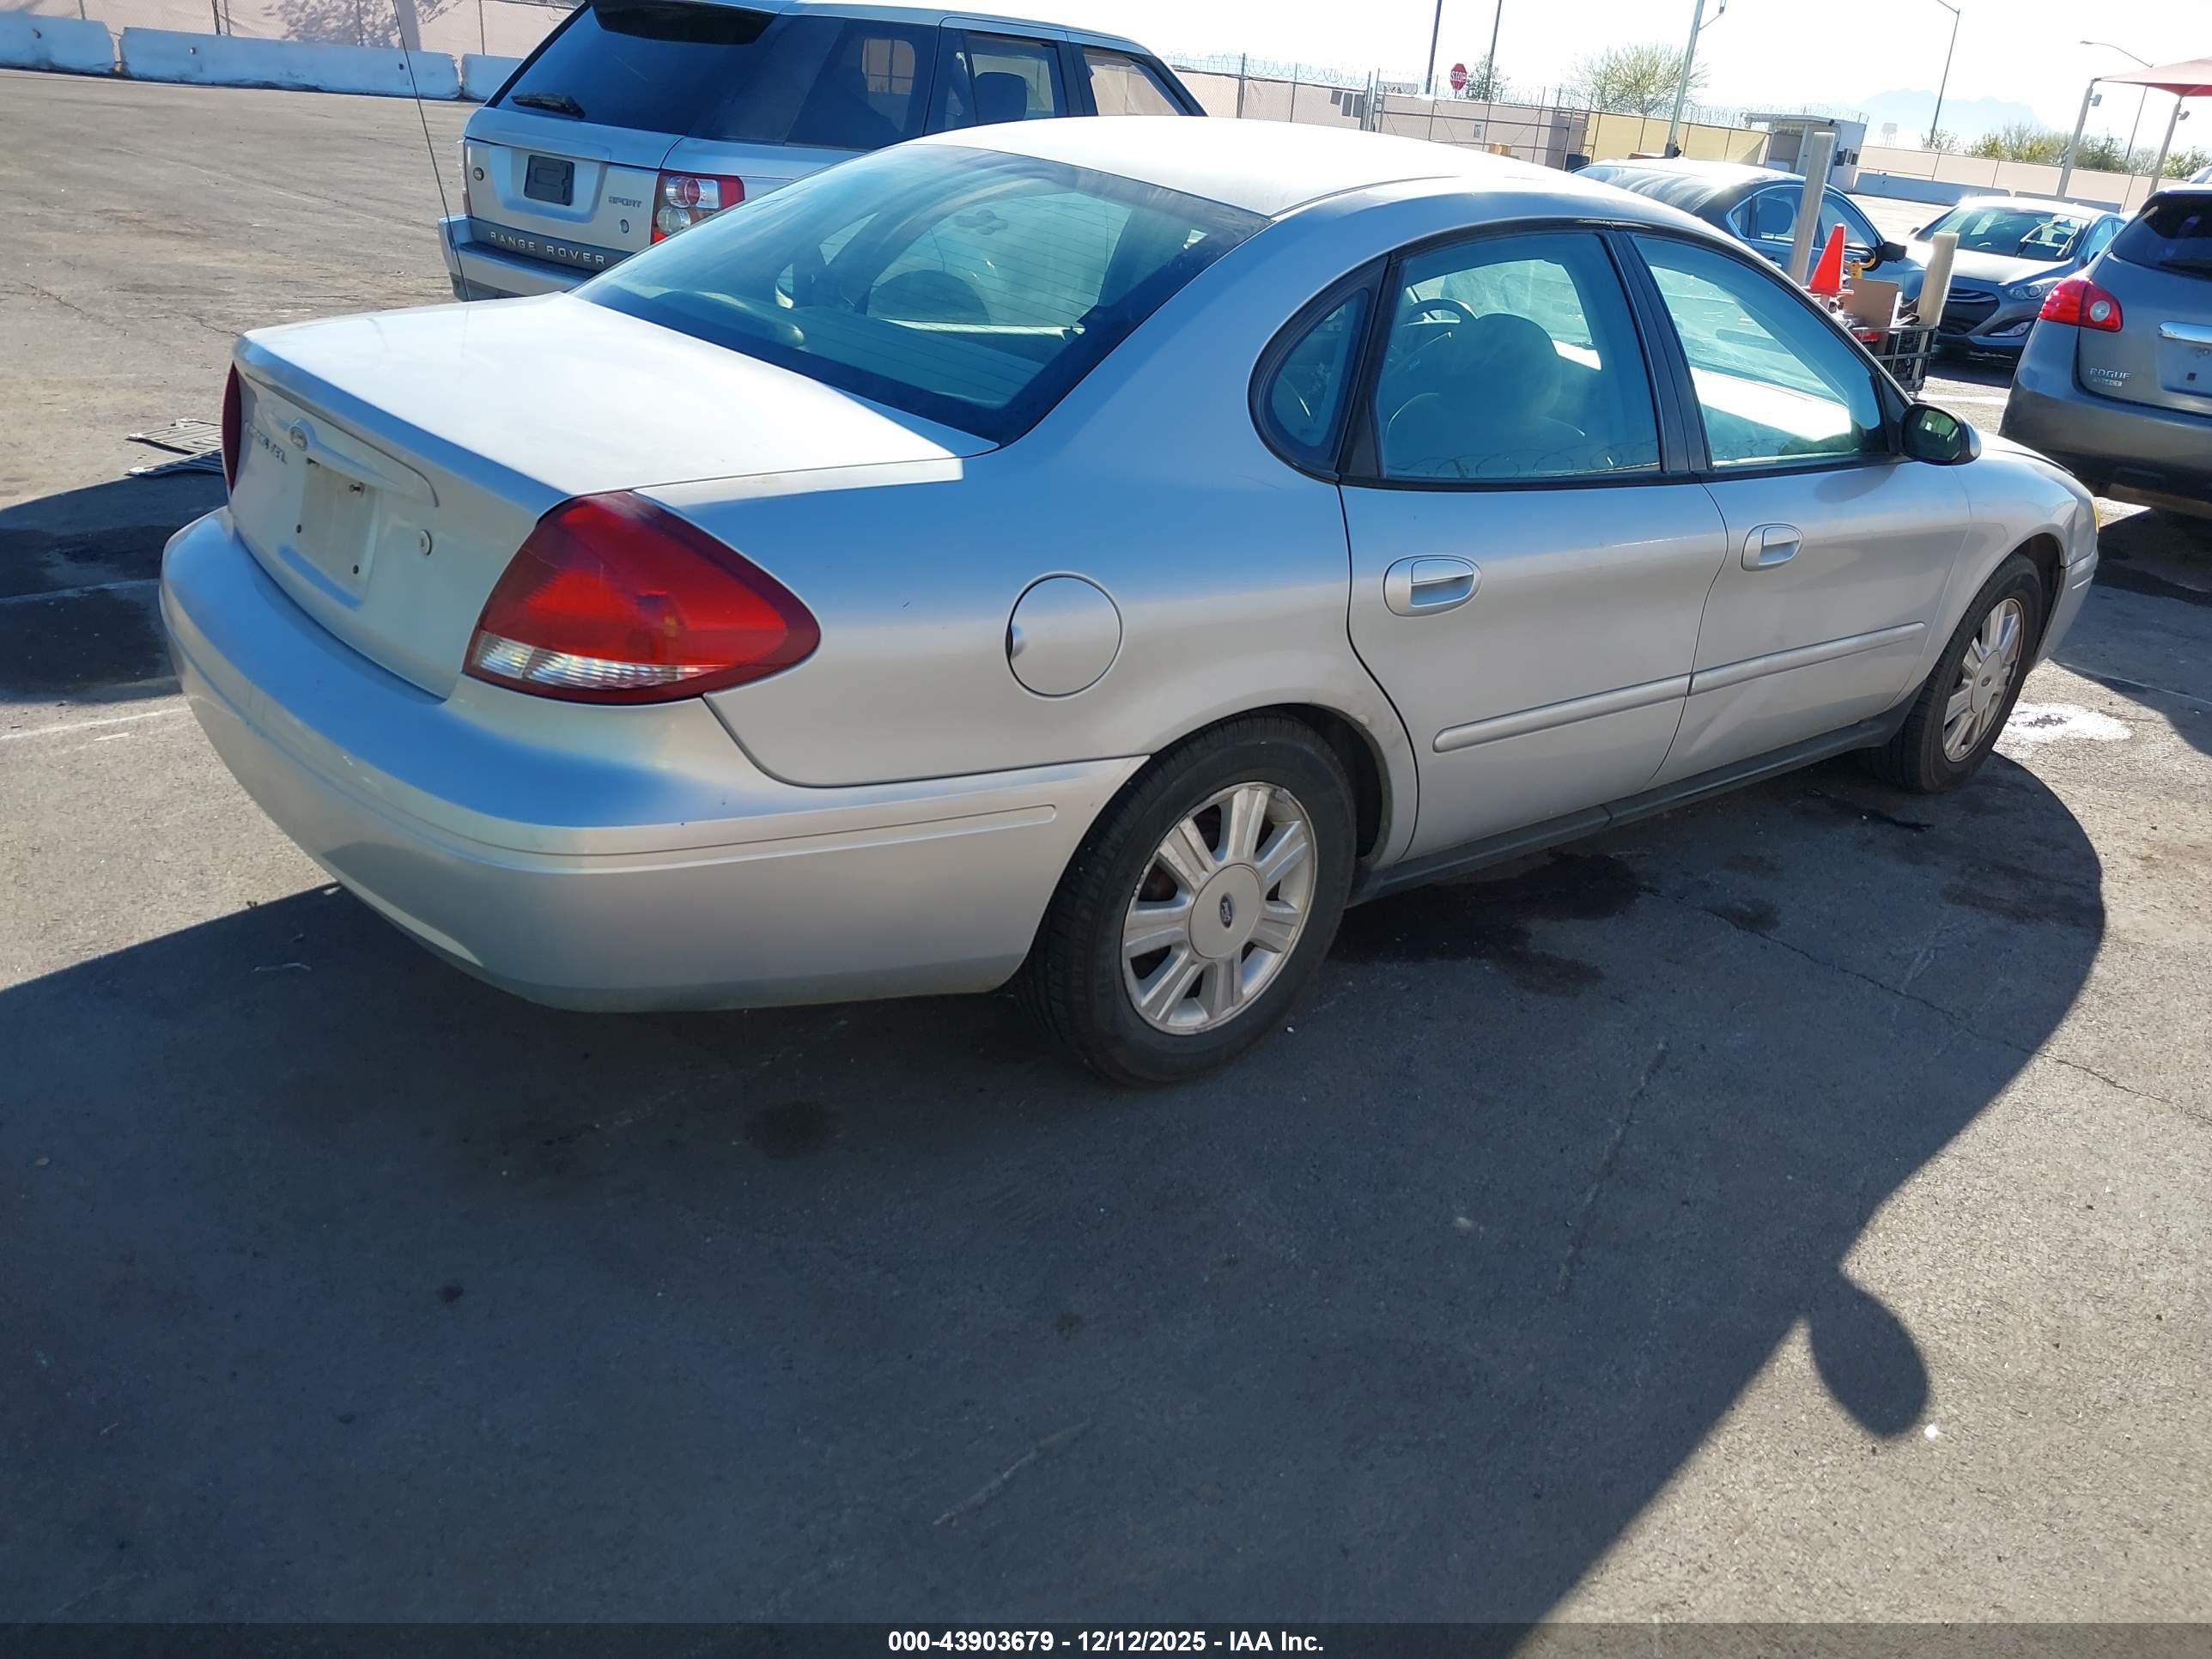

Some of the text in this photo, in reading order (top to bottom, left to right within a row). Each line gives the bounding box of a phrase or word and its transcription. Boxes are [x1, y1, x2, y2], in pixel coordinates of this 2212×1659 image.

[1450, 71, 1467, 82] STOP
[608, 196, 642, 208] SPORT
[489, 231, 605, 265] RANGE ROVER
[2089, 368, 2130, 380] ROGUE
